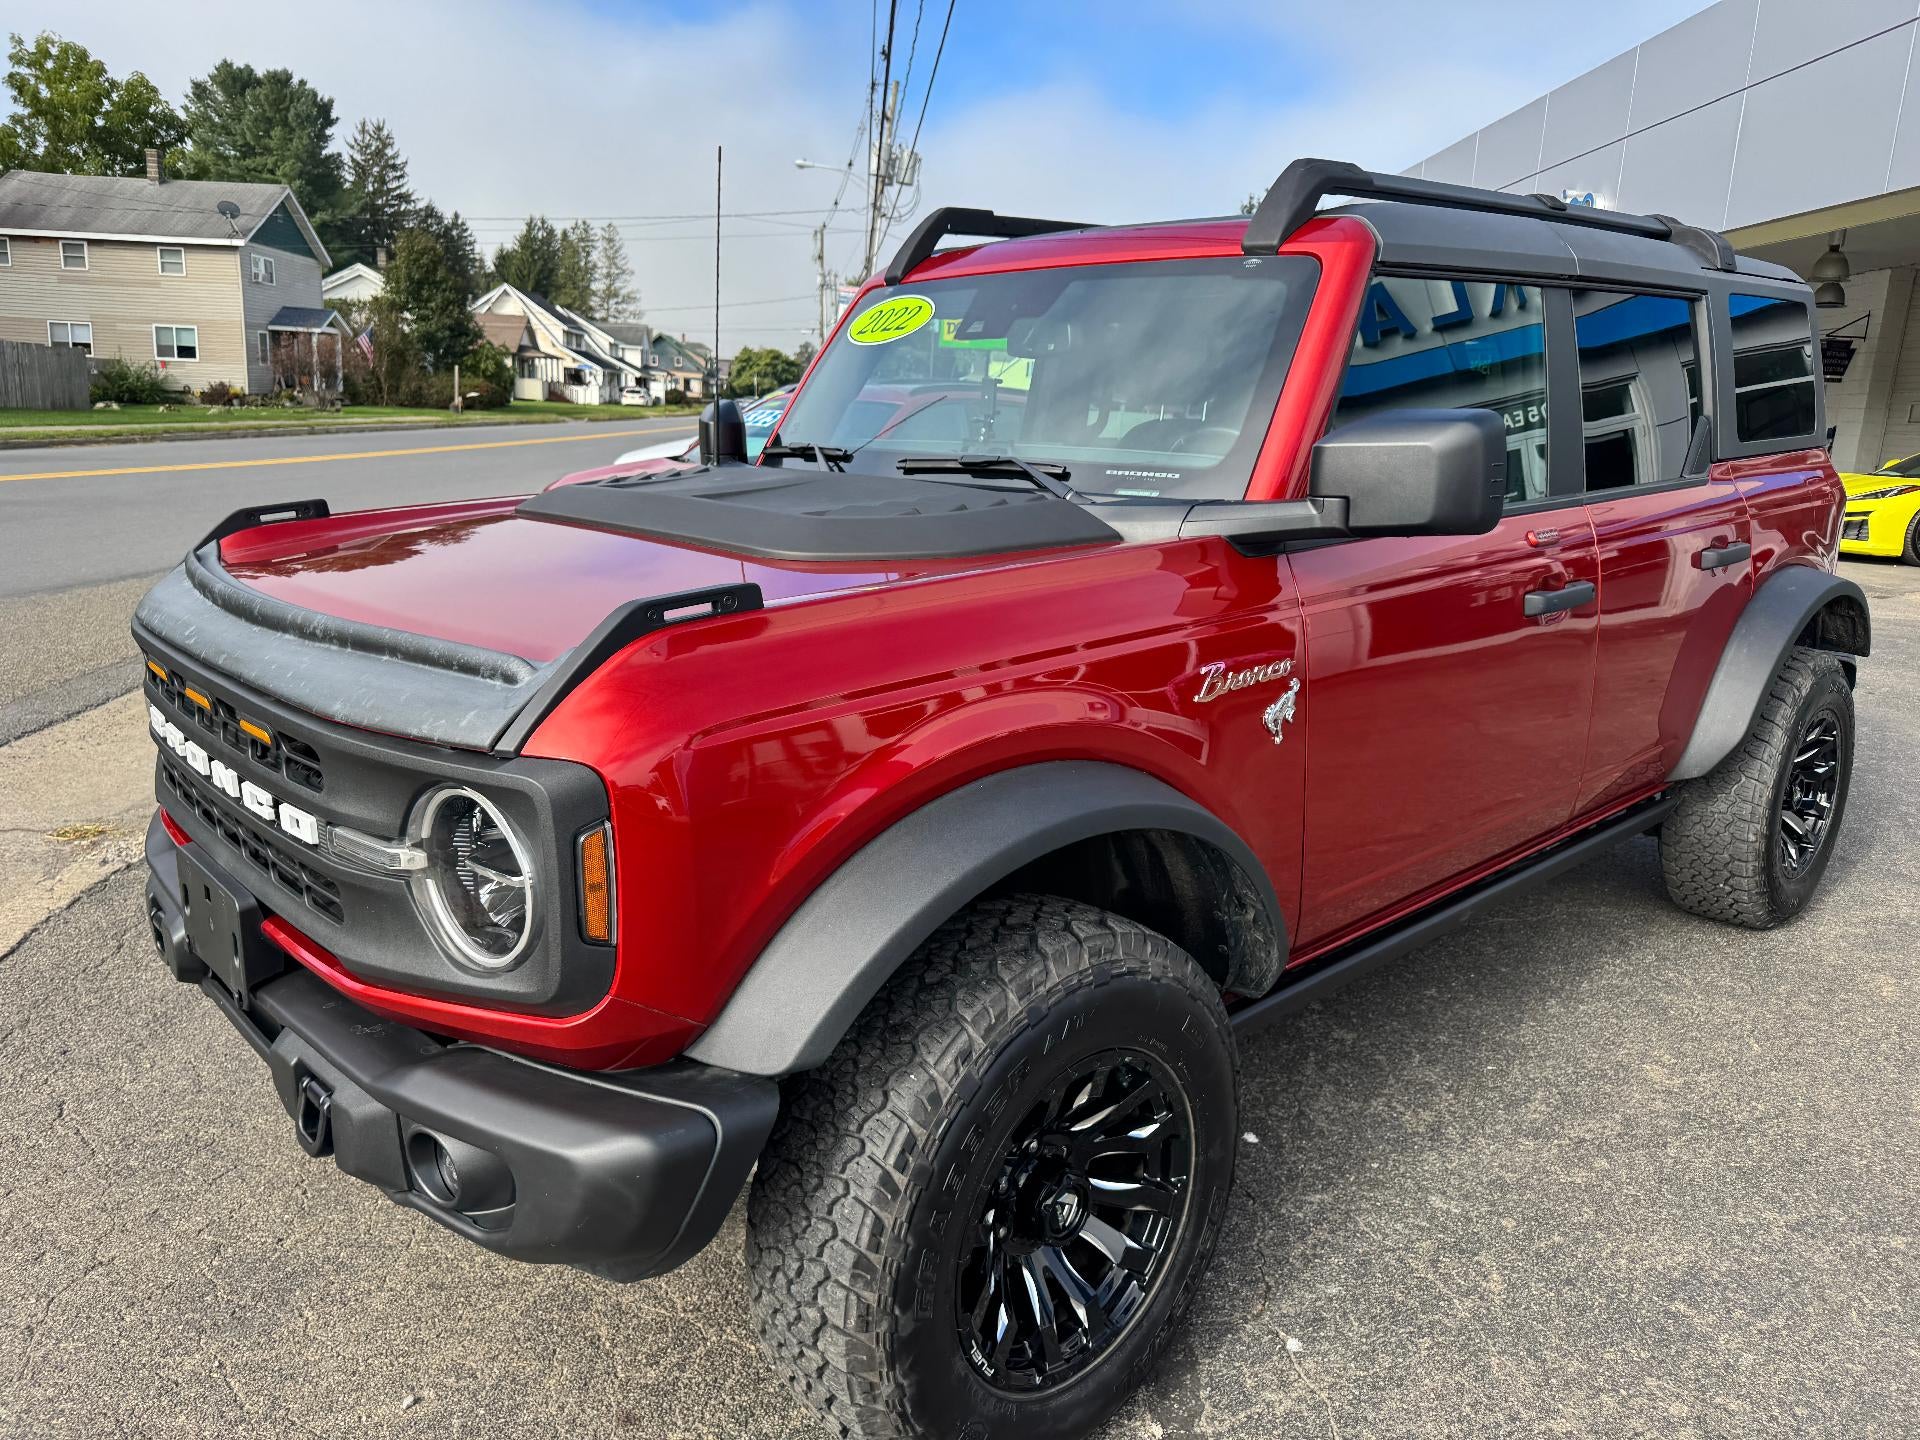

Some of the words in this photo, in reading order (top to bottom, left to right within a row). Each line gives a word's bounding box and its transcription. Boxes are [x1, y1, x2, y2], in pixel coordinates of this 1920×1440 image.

[856, 305, 923, 335] 2022
[1192, 657, 1296, 702] Bronco
[150, 703, 319, 845] BRONCO
[970, 1339, 995, 1377] FUEL
